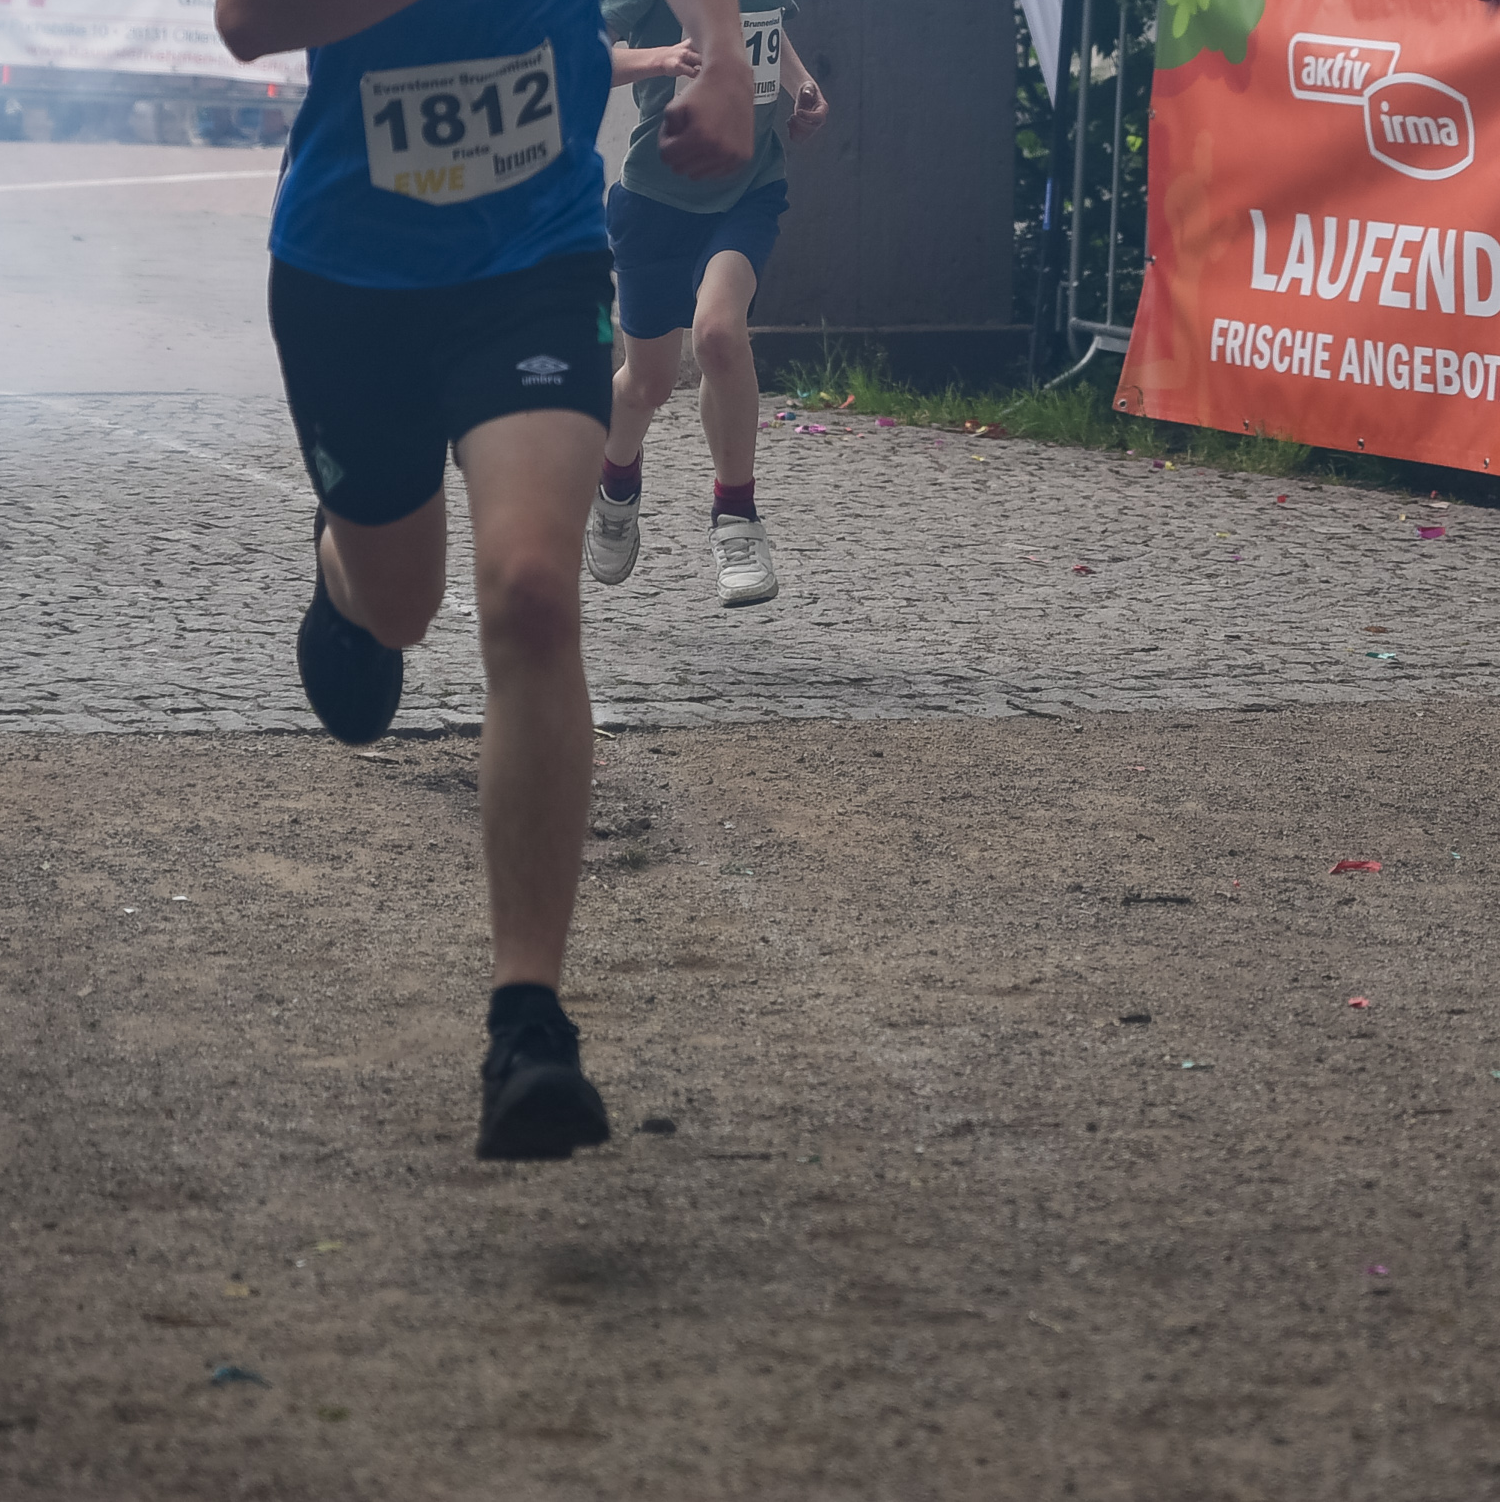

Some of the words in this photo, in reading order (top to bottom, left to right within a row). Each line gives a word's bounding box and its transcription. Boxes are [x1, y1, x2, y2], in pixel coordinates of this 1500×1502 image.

[1301, 48, 1373, 90] aktiv
[373, 69, 553, 153] 1812
[1380, 101, 1459, 148] irma
[394, 164, 465, 196] EWE
[493, 141, 547, 175] bruns
[1210, 318, 1334, 381] FRISCHE
